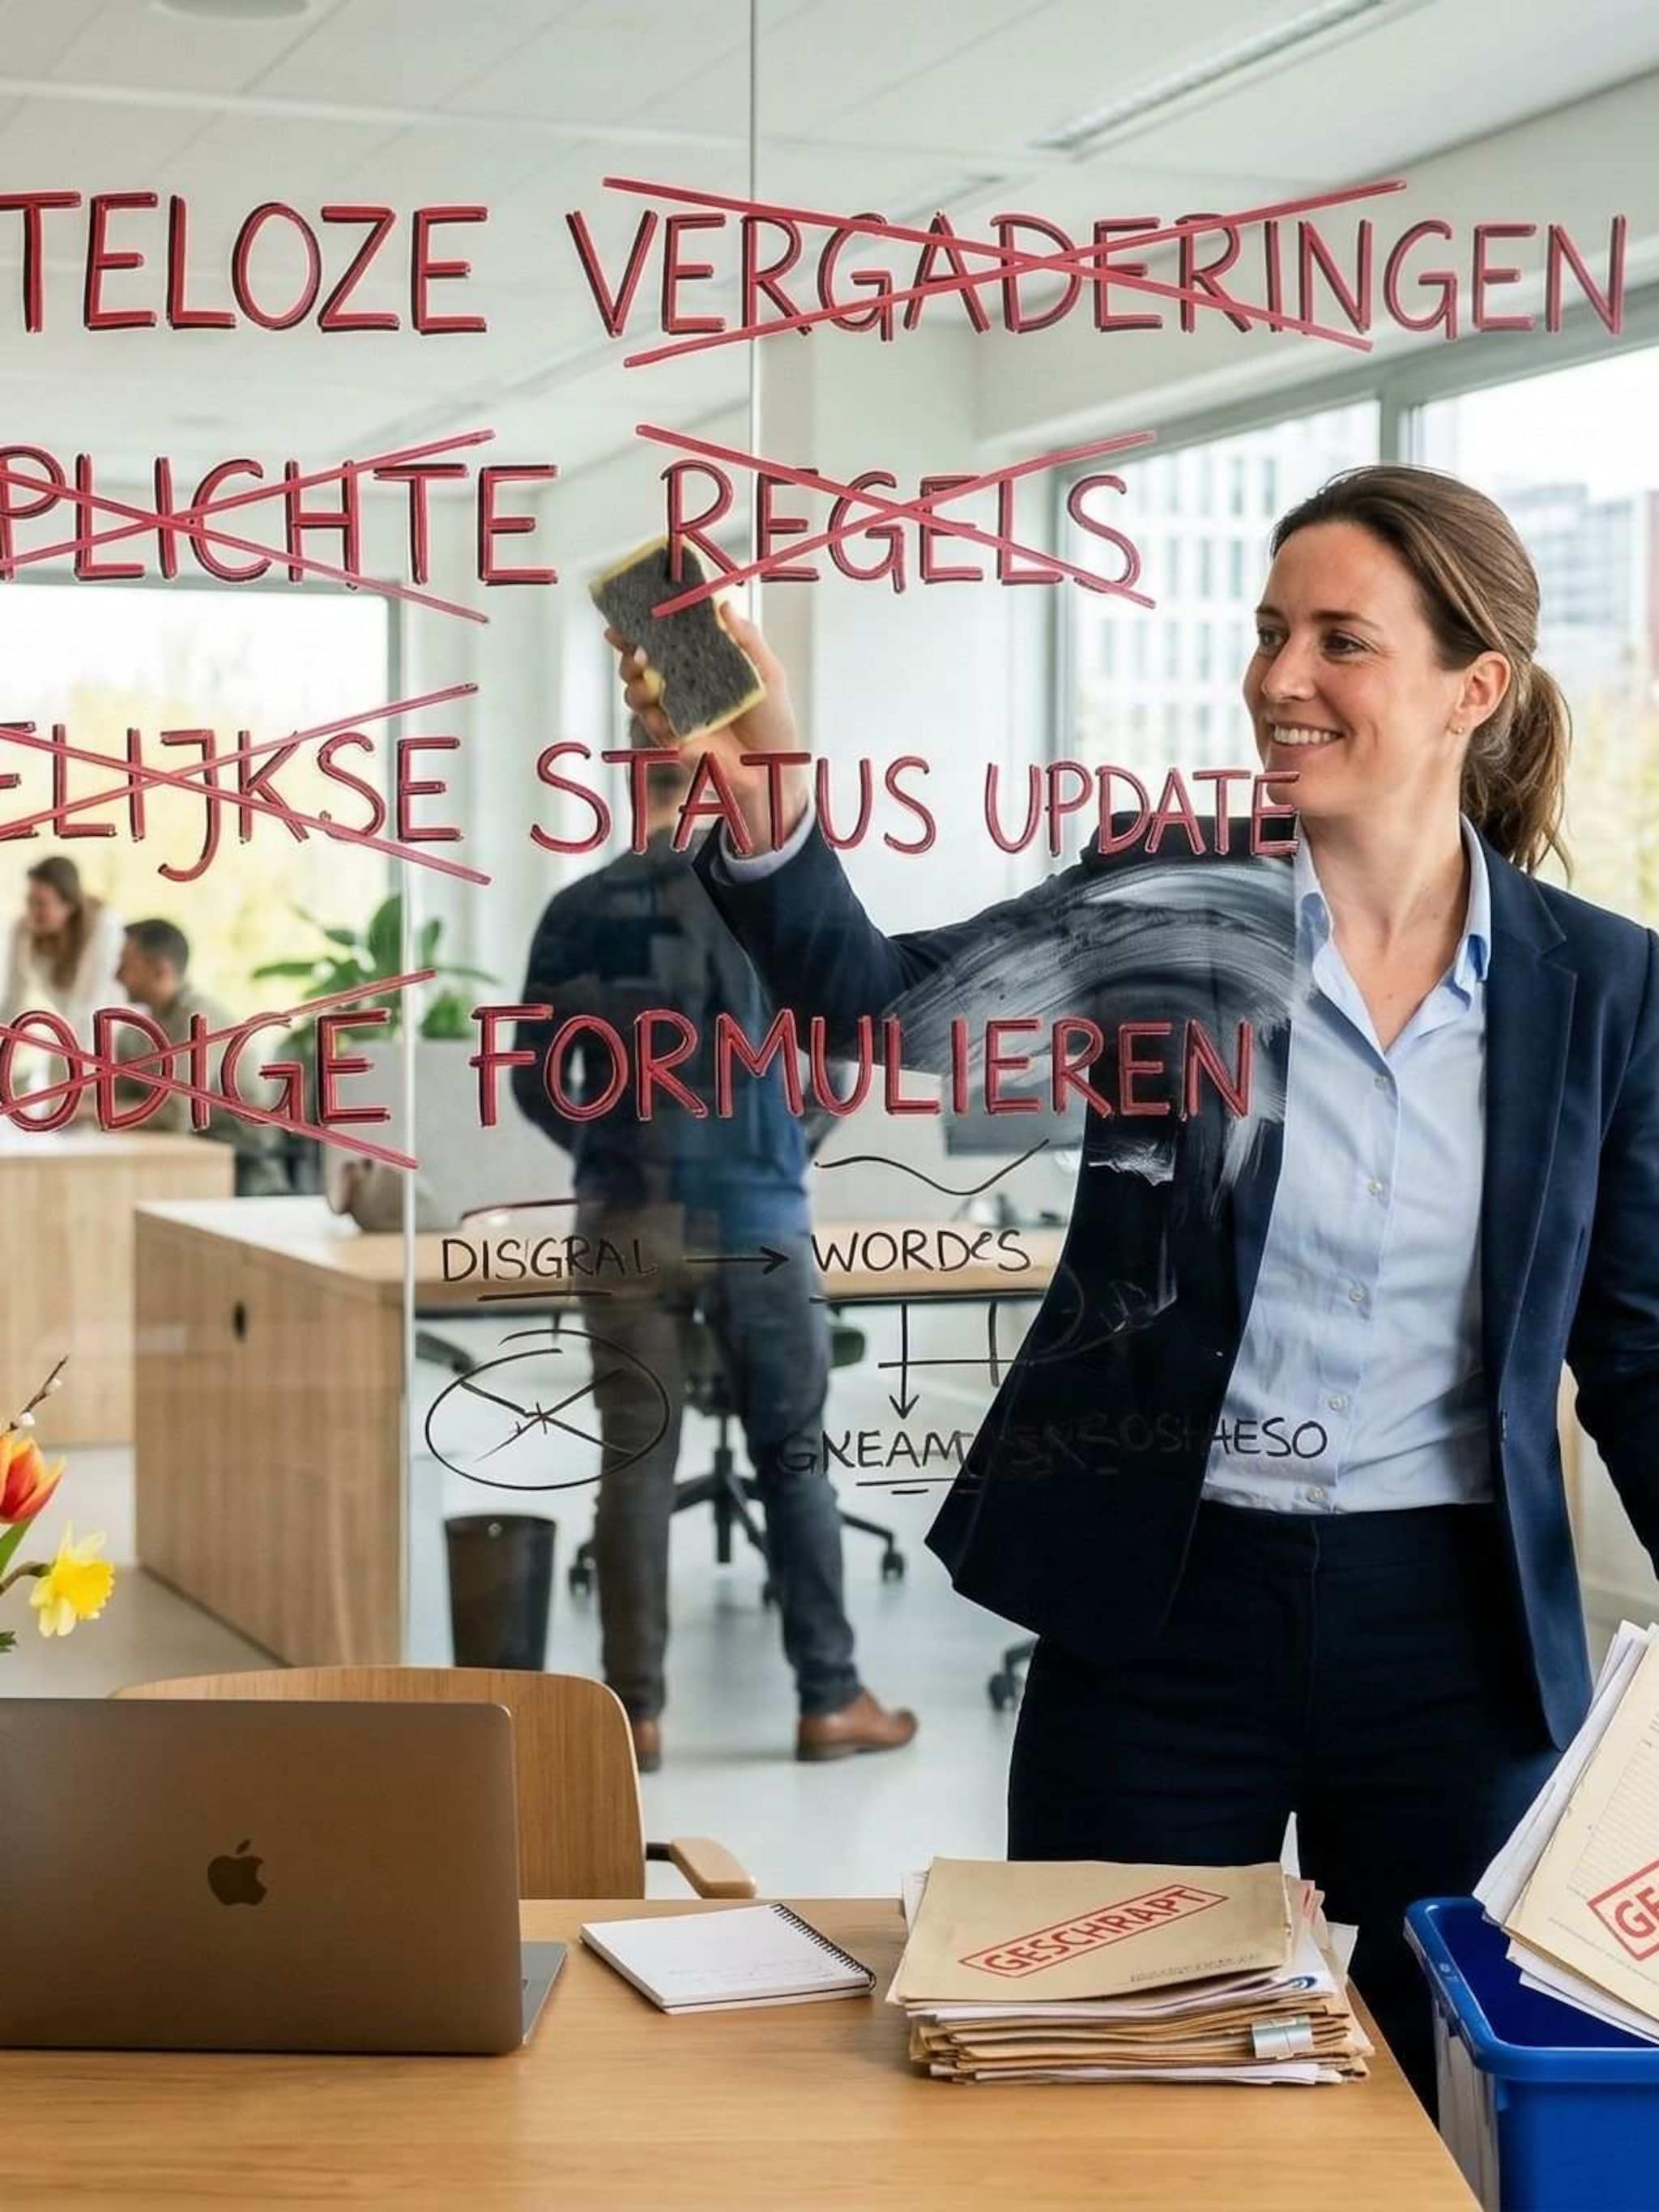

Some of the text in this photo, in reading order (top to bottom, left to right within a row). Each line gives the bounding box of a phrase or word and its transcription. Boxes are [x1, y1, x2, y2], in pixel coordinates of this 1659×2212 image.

[0, 191, 1627, 341] TELOZE VERGADERINGEN
[0, 446, 1141, 594] PLICHTE REGELS
[530, 741, 936, 856] STATUS
[984, 760, 1300, 857] UPDATE
[0, 1003, 1255, 1132] ODIGE FORMULIEREN
[983, 1889, 1207, 1971] GESCHRAPT
